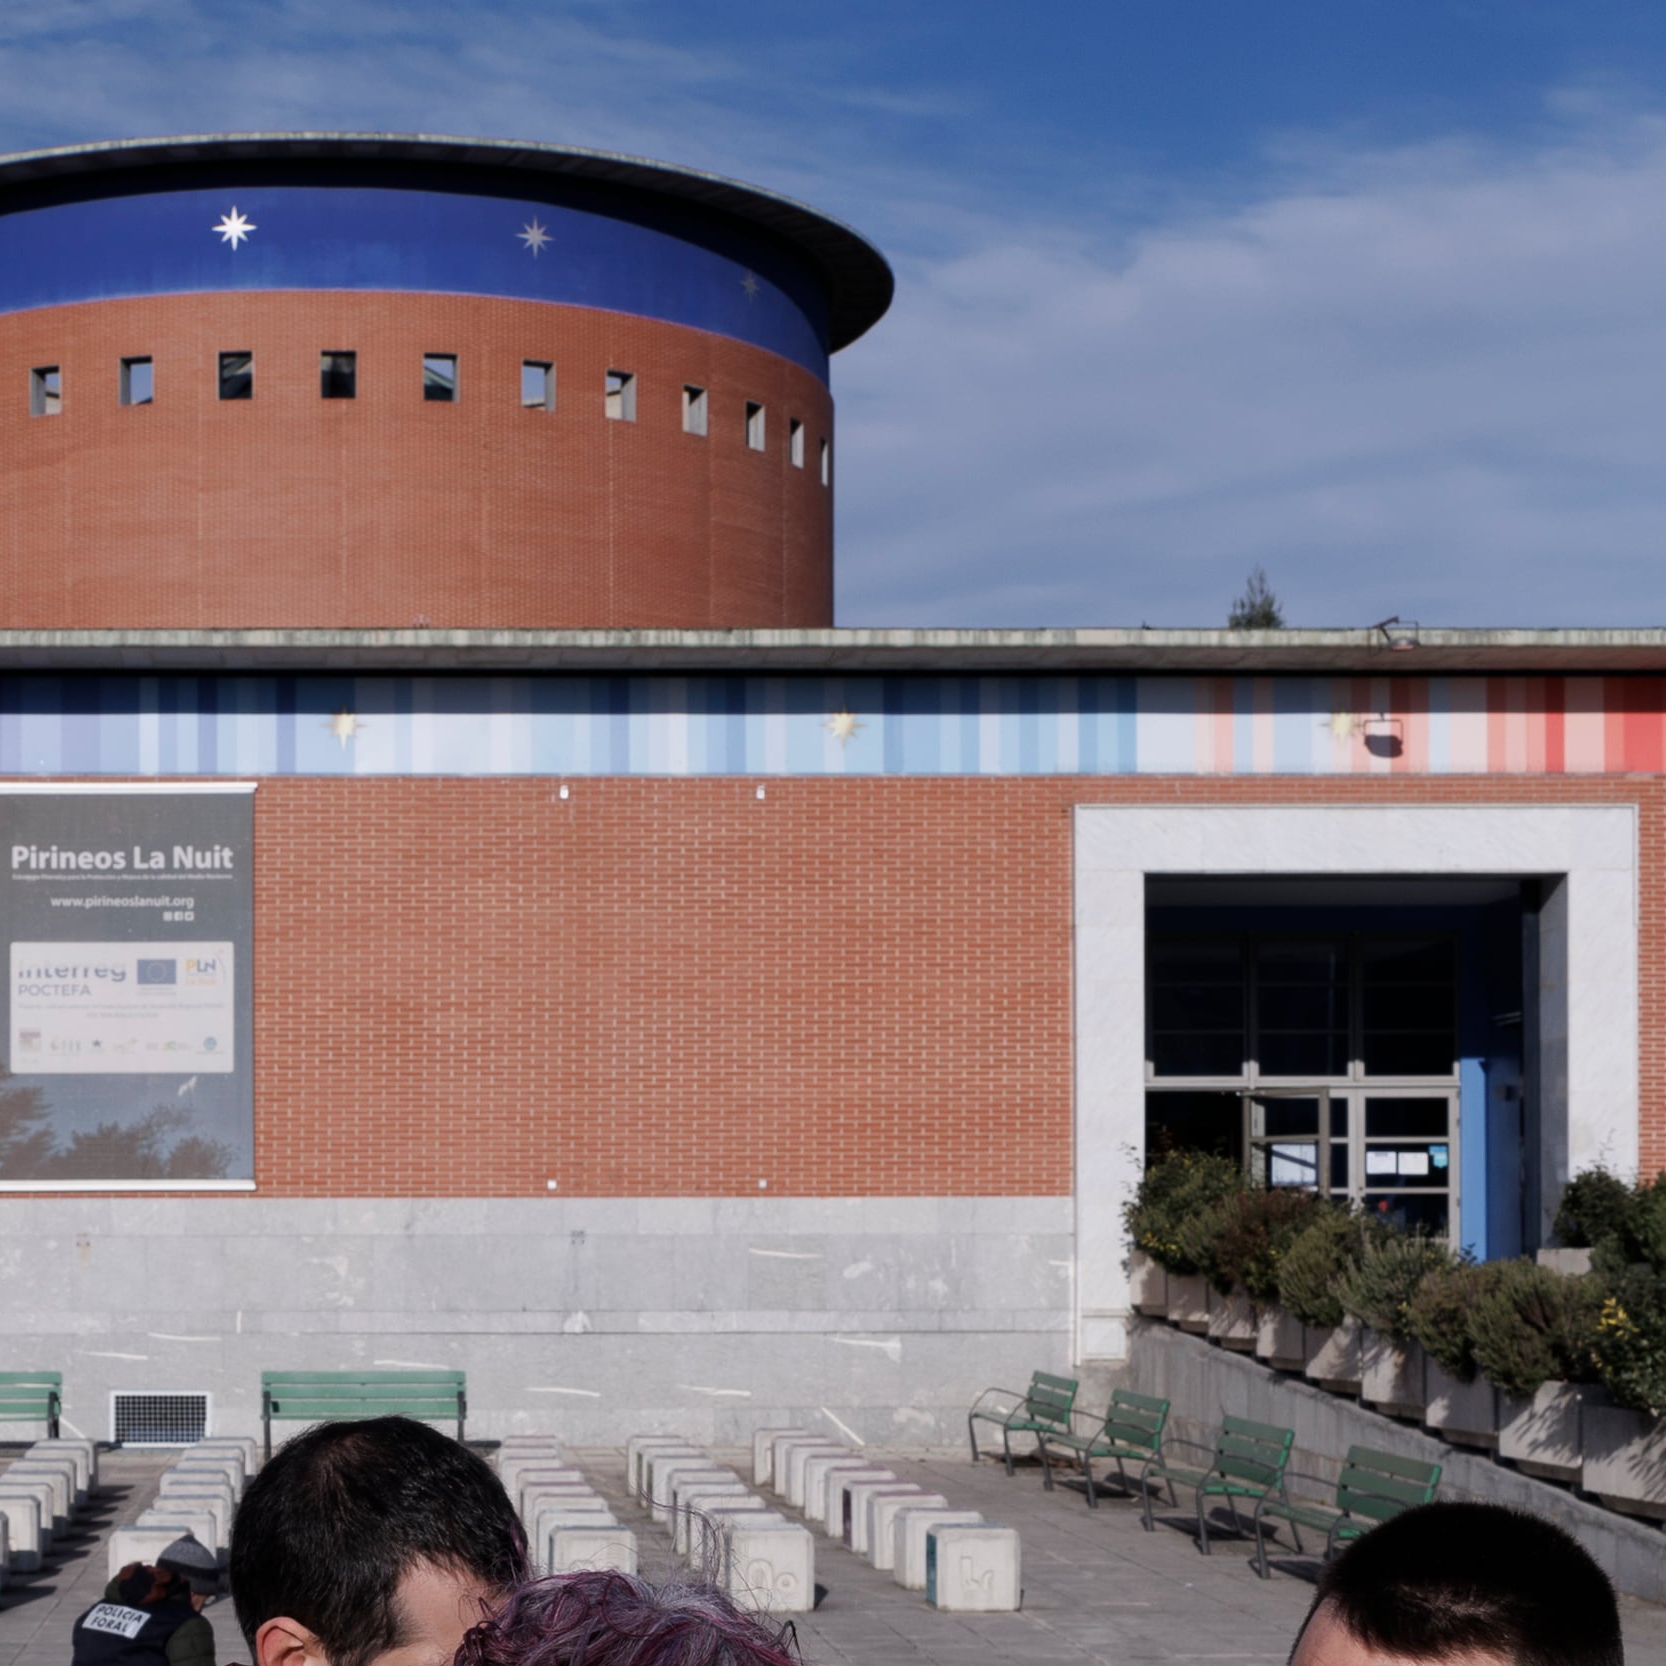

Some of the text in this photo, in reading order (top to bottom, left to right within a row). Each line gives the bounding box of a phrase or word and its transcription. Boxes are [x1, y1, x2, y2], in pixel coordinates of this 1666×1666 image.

[11, 845, 234, 870] Pirineos La Nuit
[50, 895, 194, 910] www.pirineoslanuit.org
[17, 984, 92, 997] POCTEFA
[91, 1616, 129, 1633] FORAL
